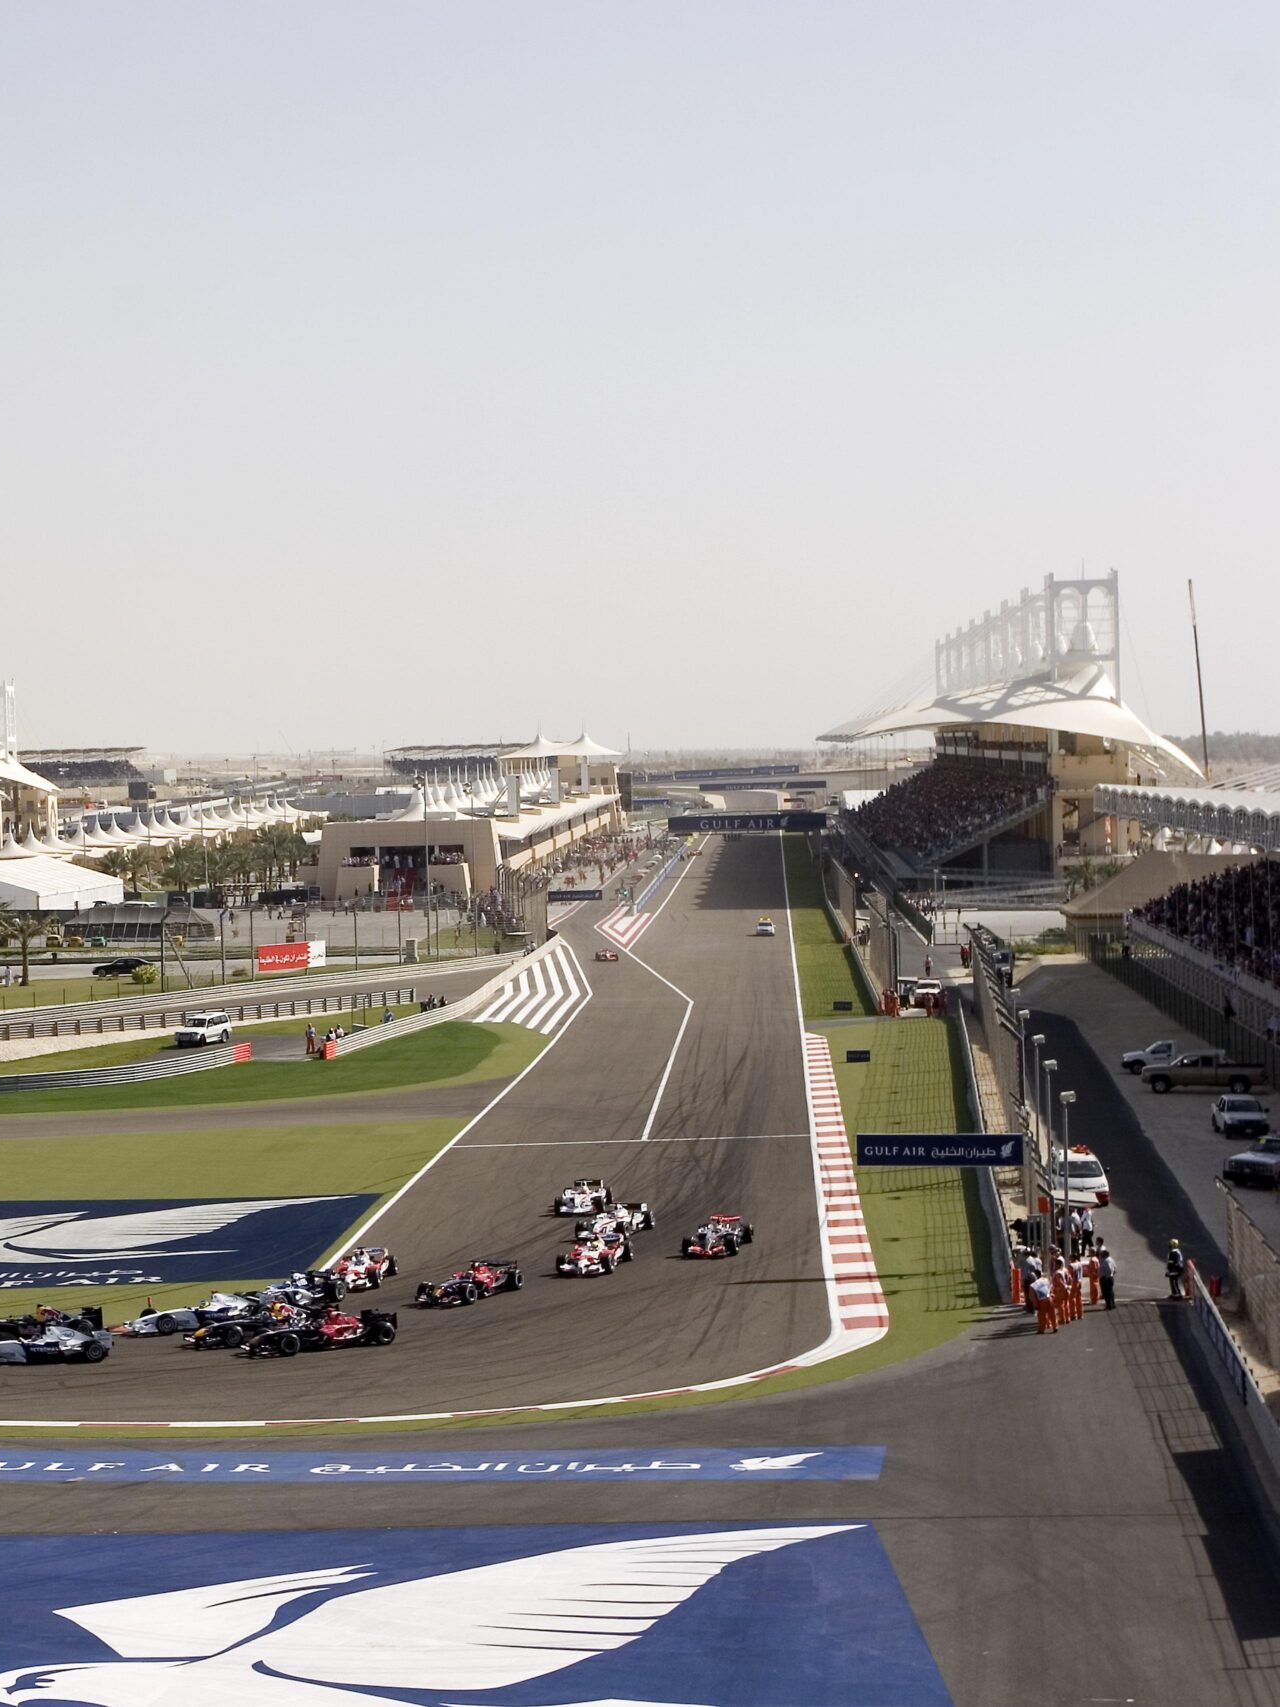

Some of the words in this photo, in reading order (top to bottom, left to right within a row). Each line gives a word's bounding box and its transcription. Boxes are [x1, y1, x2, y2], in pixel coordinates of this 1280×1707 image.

[699, 820, 741, 830] GULF
[748, 819, 775, 829] AIR
[864, 1146, 900, 1156] GULF
[902, 1146, 926, 1156] AIR
[931, 1146, 964, 1159] الخليج
[965, 1146, 997, 1159] طيران
[56, 1276, 164, 1286] AIR
[140, 1463, 271, 1474] AIR
[309, 1461, 510, 1475] الخليج
[516, 1460, 702, 1474] طيران
